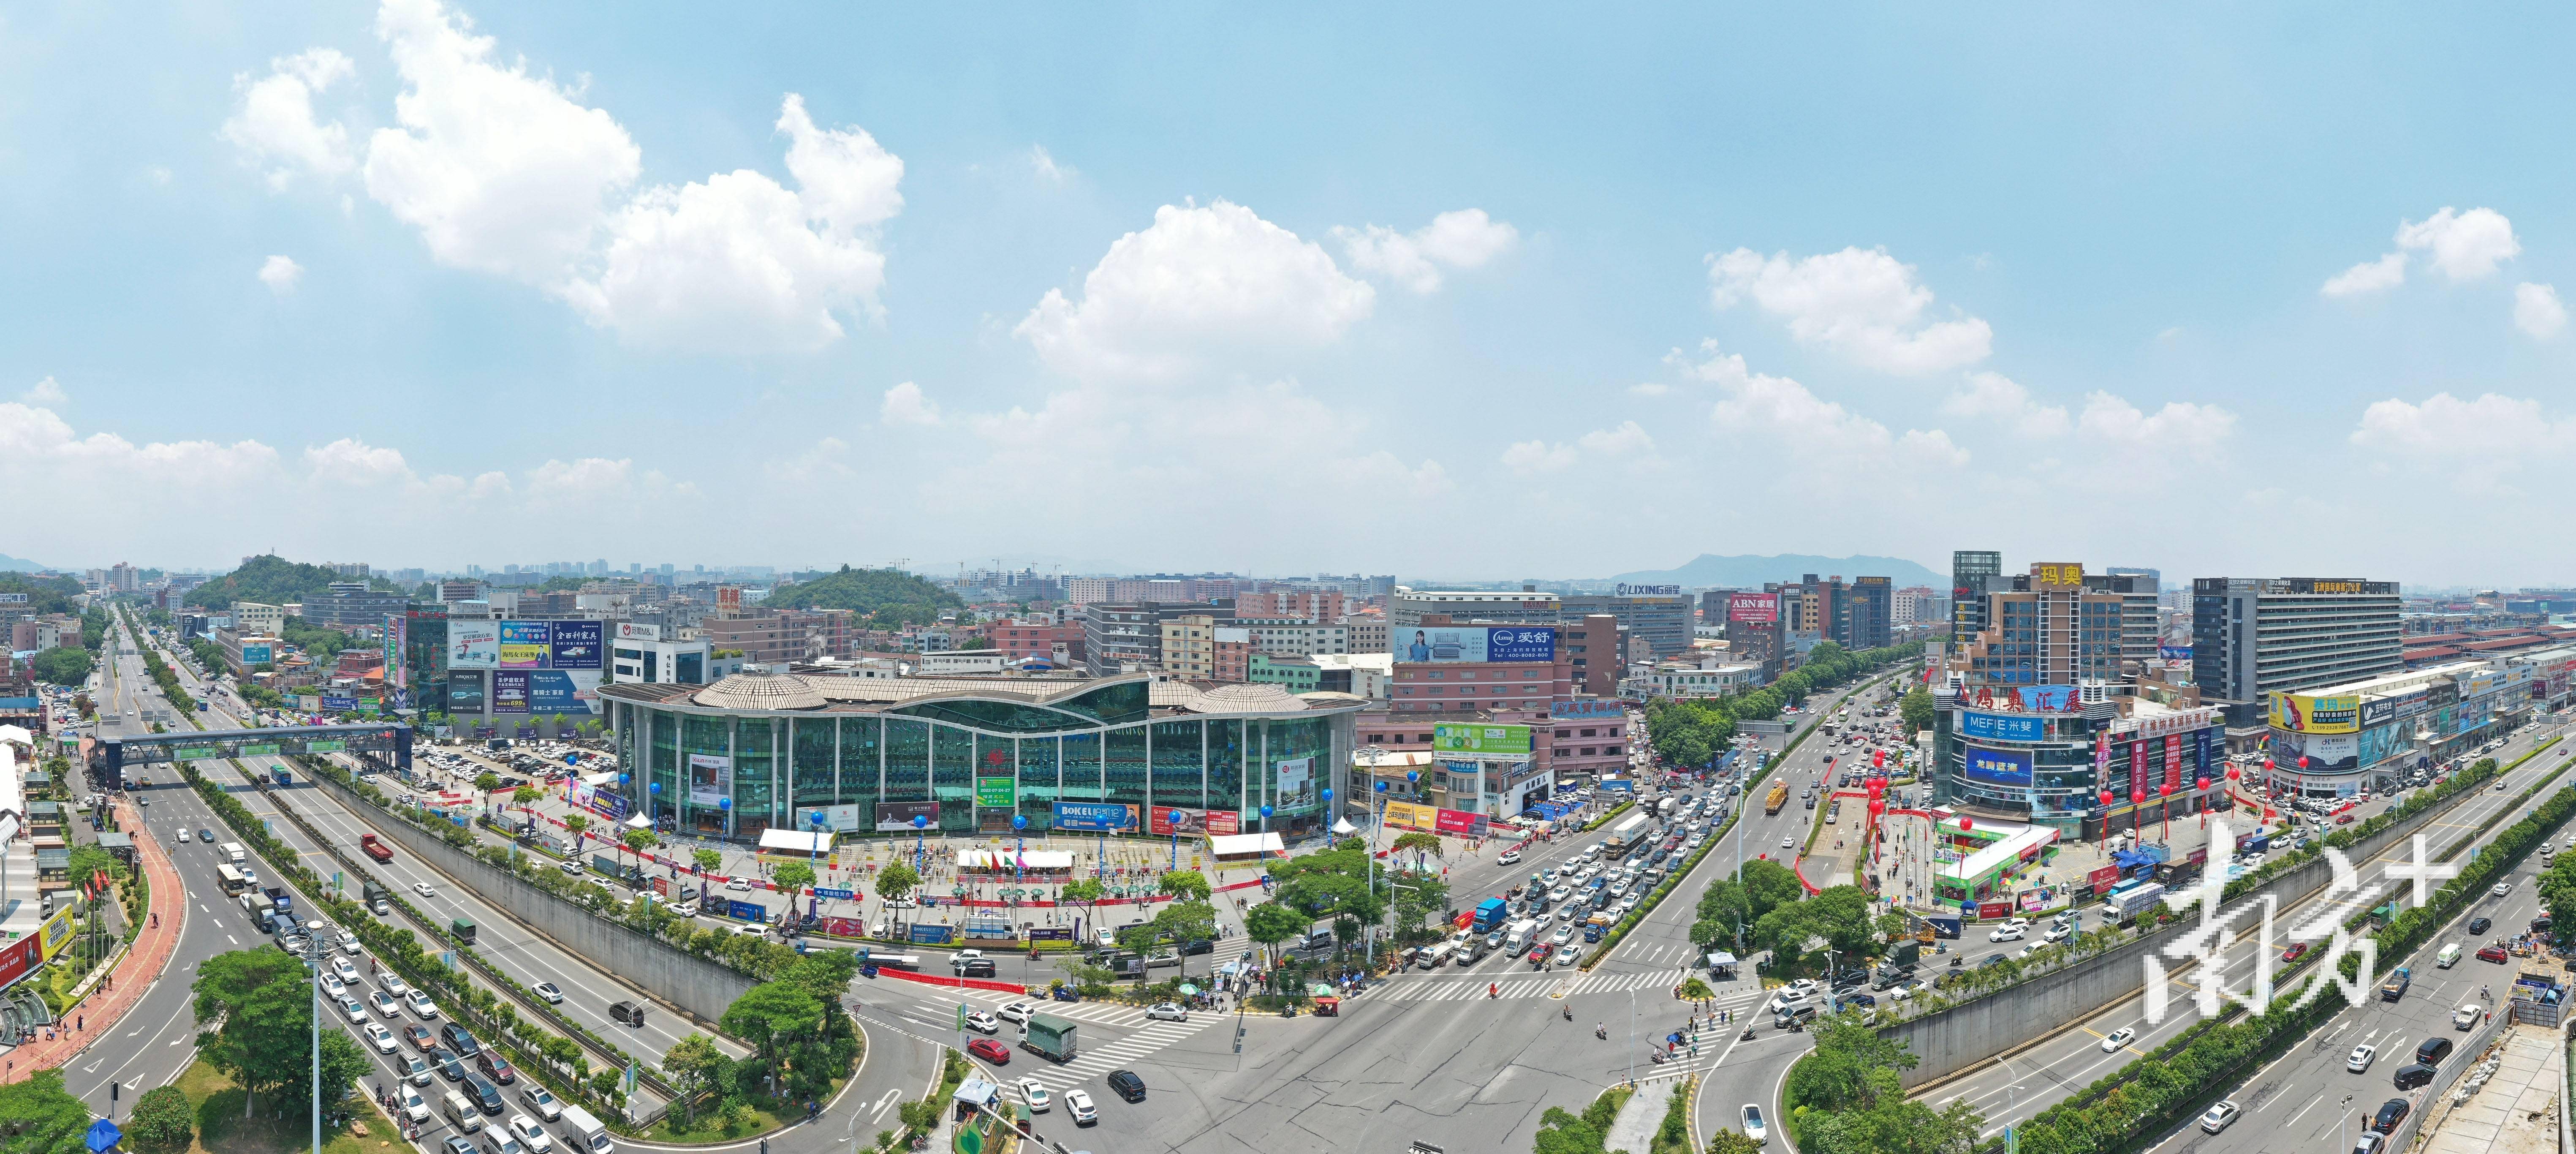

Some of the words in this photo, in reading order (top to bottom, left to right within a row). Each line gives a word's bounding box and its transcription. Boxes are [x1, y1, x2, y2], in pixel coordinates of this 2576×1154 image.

[2040, 565, 2081, 585] 玛奥
[1628, 585, 1664, 595] LIXING
[1665, 585, 1680, 595] 丽星
[2313, 582, 2361, 592] 亚洲国际奥斯汀公寓
[1732, 599, 1756, 608] ABN
[1757, 600, 1774, 608] 家居
[1957, 603, 1965, 652] 奥斯汀柏丽
[556, 631, 597, 641] 金百利家具
[1517, 631, 1550, 643] 爱舒
[1976, 687, 2085, 713] 玛奥汇展
[2313, 698, 2338, 711] 赛玛
[2008, 720, 2031, 732] 米斐
[2149, 710, 2210, 731] 维纳斯国际酒店
[1976, 759, 2018, 773] 龙腾蓝海
[1062, 806, 1092, 816] BOKEL
[823, 890, 851, 898] 核酸检测点
[10, 956, 20, 966] 真品质
